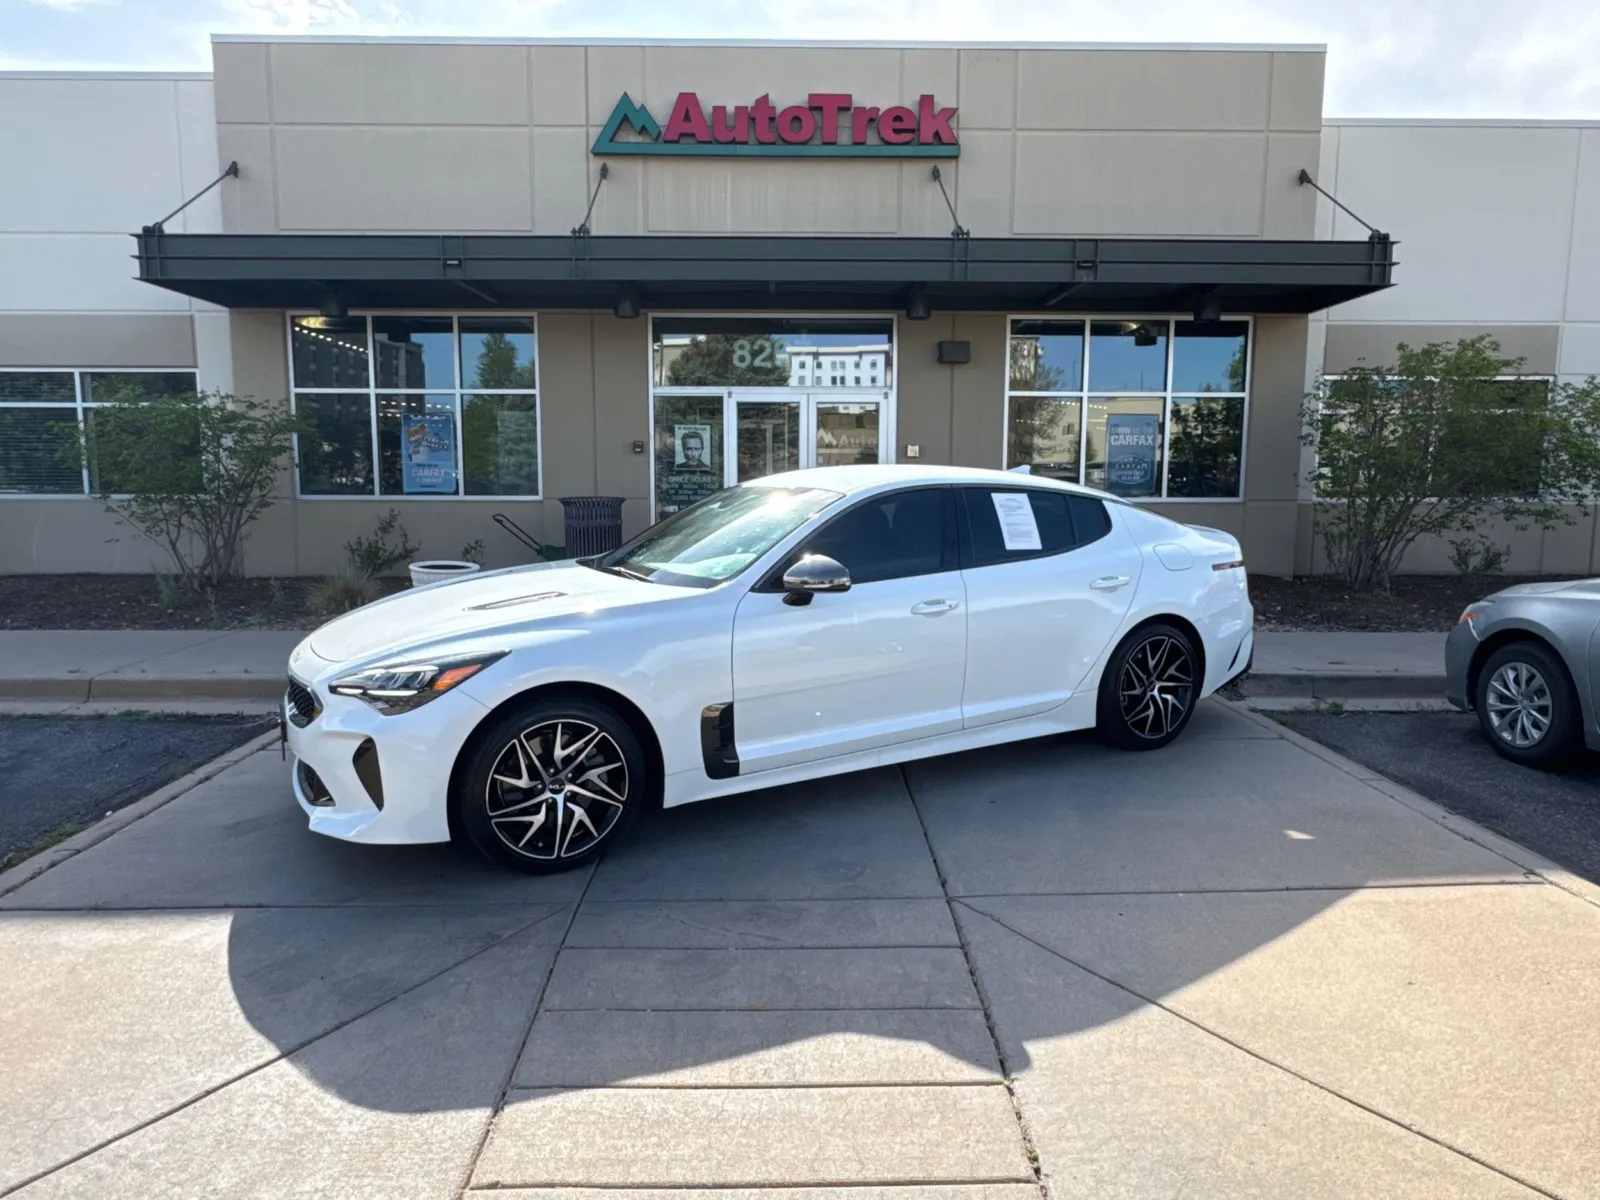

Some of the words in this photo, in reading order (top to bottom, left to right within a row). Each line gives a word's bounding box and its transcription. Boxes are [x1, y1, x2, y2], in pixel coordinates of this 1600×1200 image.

[662, 92, 959, 146] AutoTrek
[1110, 435, 1154, 446] CARFAX
[412, 468, 446, 477] CARFAX
